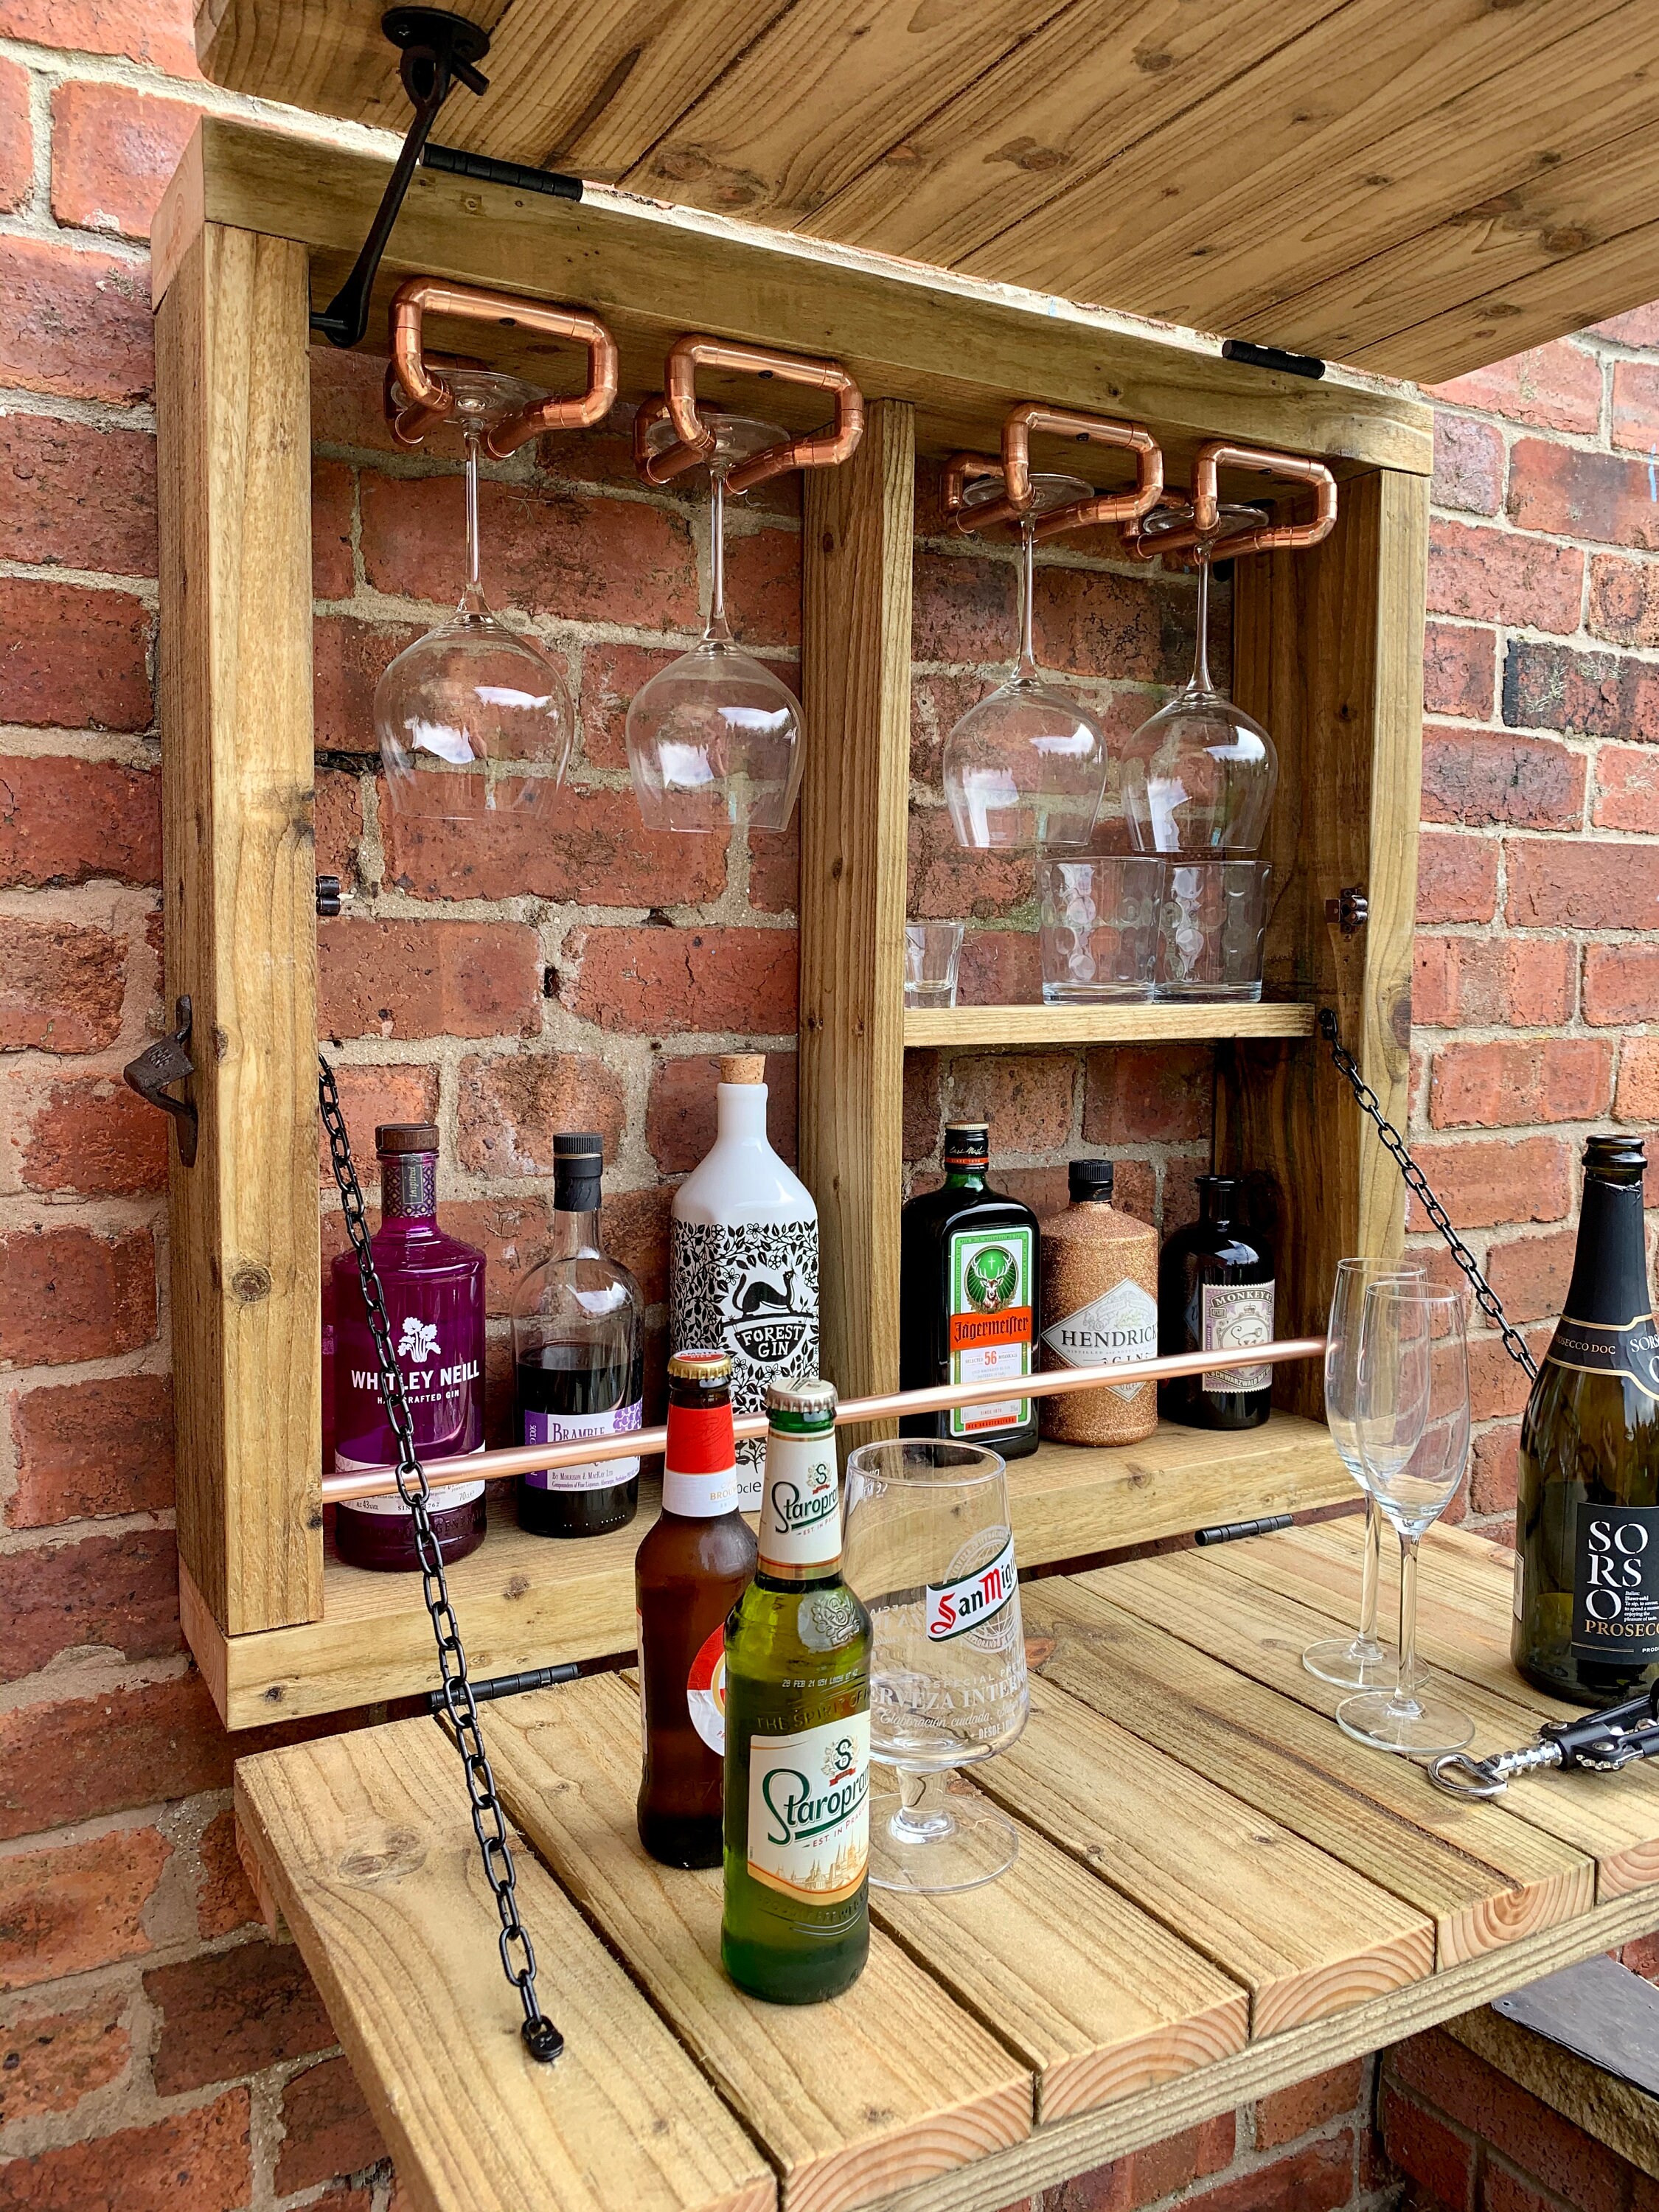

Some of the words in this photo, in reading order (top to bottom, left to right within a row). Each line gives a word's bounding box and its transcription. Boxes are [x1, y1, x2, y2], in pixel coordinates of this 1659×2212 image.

[1214, 1290, 1265, 1307] MONKEY
[1265, 1293, 1273, 1301] 47
[740, 1324, 804, 1347] FOREST
[1556, 1335, 1590, 1352] OSECCO
[1591, 1344, 1616, 1354] DOC
[758, 1340, 790, 1357] GIN
[984, 1350, 998, 1366] 56
[351, 1369, 434, 1391] WHTEY
[440, 1360, 480, 1387] NEILL
[1211, 1370, 1258, 1387] SCHWARZWALD
[378, 1393, 442, 1405] HCRAFTED
[445, 1389, 460, 1399] GIN
[771, 1481, 839, 1534] Staropra
[1587, 1520, 1649, 1555] SO
[1586, 1553, 1643, 1588] RS
[930, 1589, 983, 1635] San
[1585, 1588, 1622, 1621] O
[782, 1679, 791, 1688] 28
[793, 1680, 806, 1688] FEB
[808, 1679, 815, 1688] 21
[922, 1673, 995, 1689] ESPECIAL
[869, 1684, 956, 1711] ERVEZA
[756, 1715, 790, 1731] THE
[879, 1708, 947, 1728] Elaboración
[813, 1834, 830, 1848] EST.
[834, 1826, 843, 1838] IN
